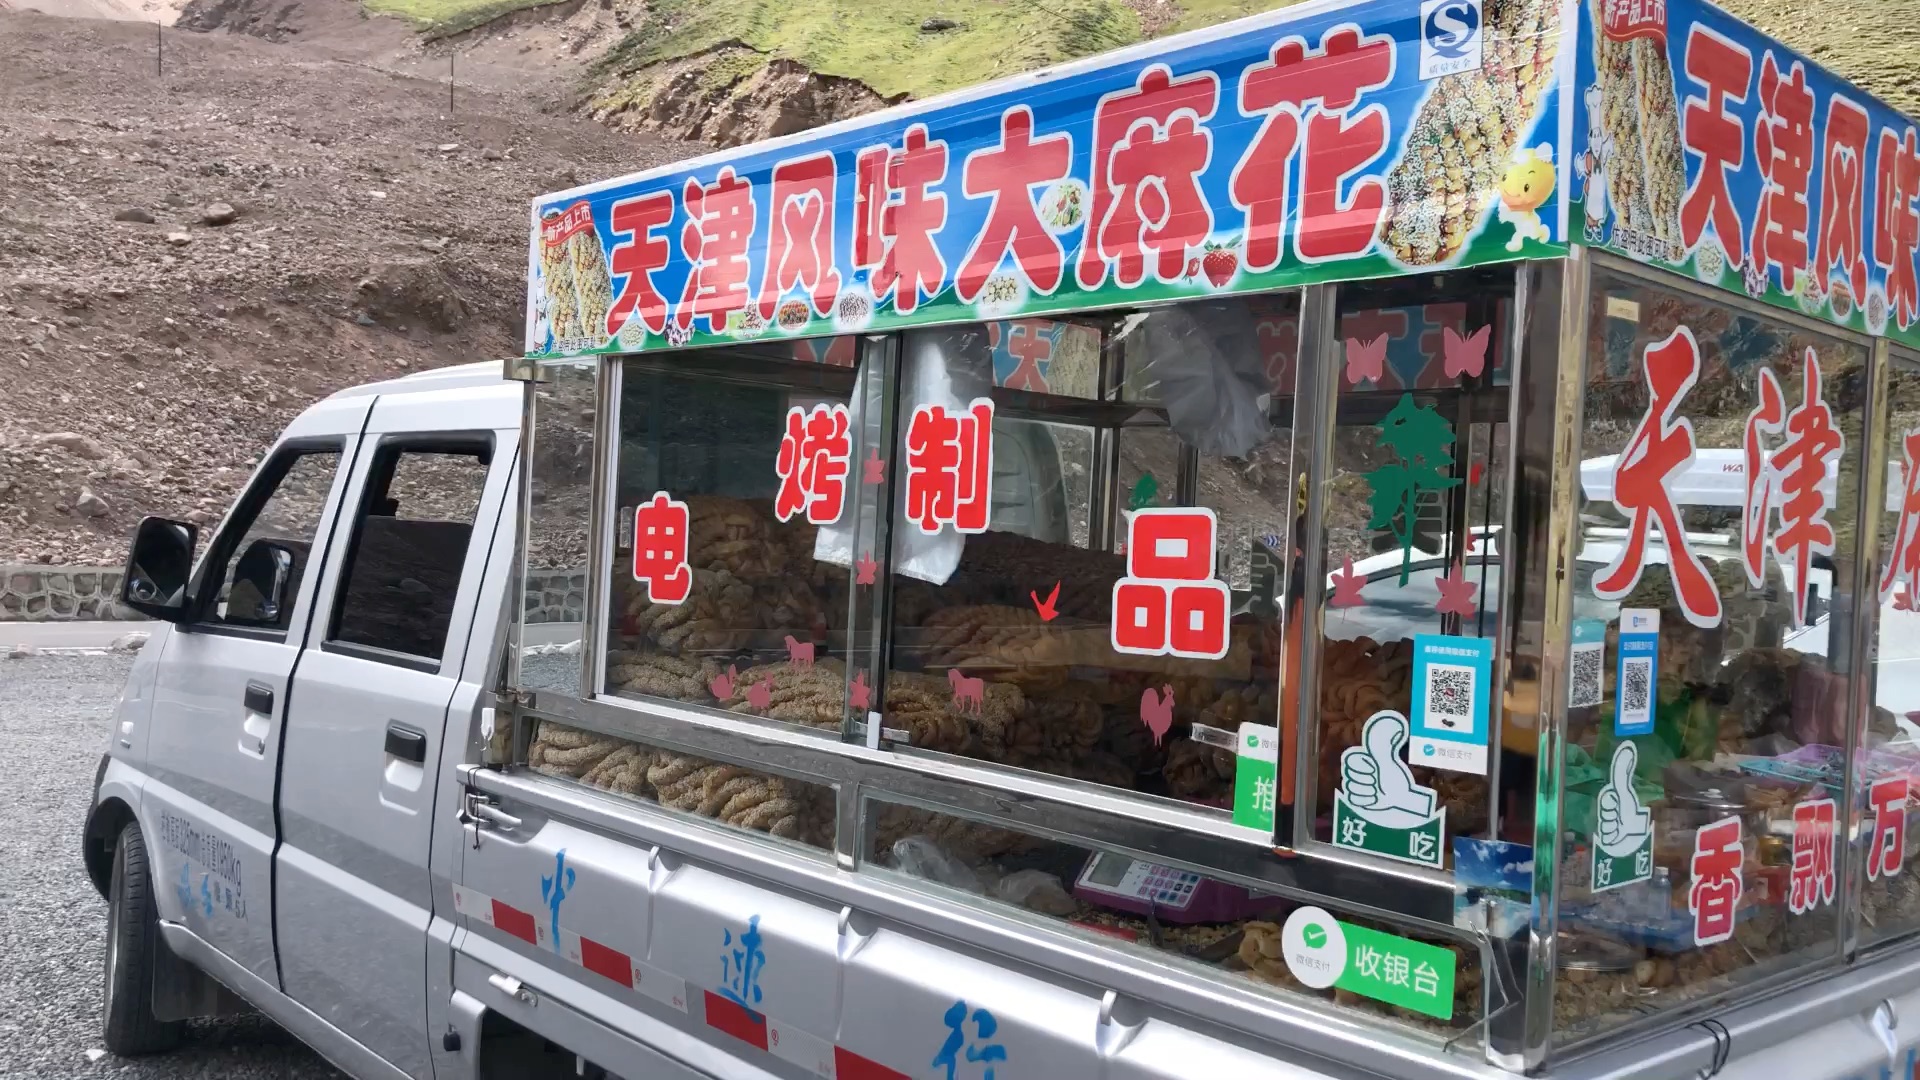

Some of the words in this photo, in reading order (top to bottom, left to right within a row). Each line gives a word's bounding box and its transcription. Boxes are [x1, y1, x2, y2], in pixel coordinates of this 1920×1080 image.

[605, 22, 1397, 337] 天津风味大麻花
[1679, 20, 1920, 331] 天津风味
[547, 205, 591, 242] 新产品上市
[1438, 747, 1472, 760] 微信支付
[1342, 817, 1437, 861] 好吃
[1688, 775, 1909, 946] 香飘万
[1597, 852, 1650, 886] 好吃
[1295, 954, 1331, 973] 微信支付
[1355, 944, 1440, 998] 收银台
